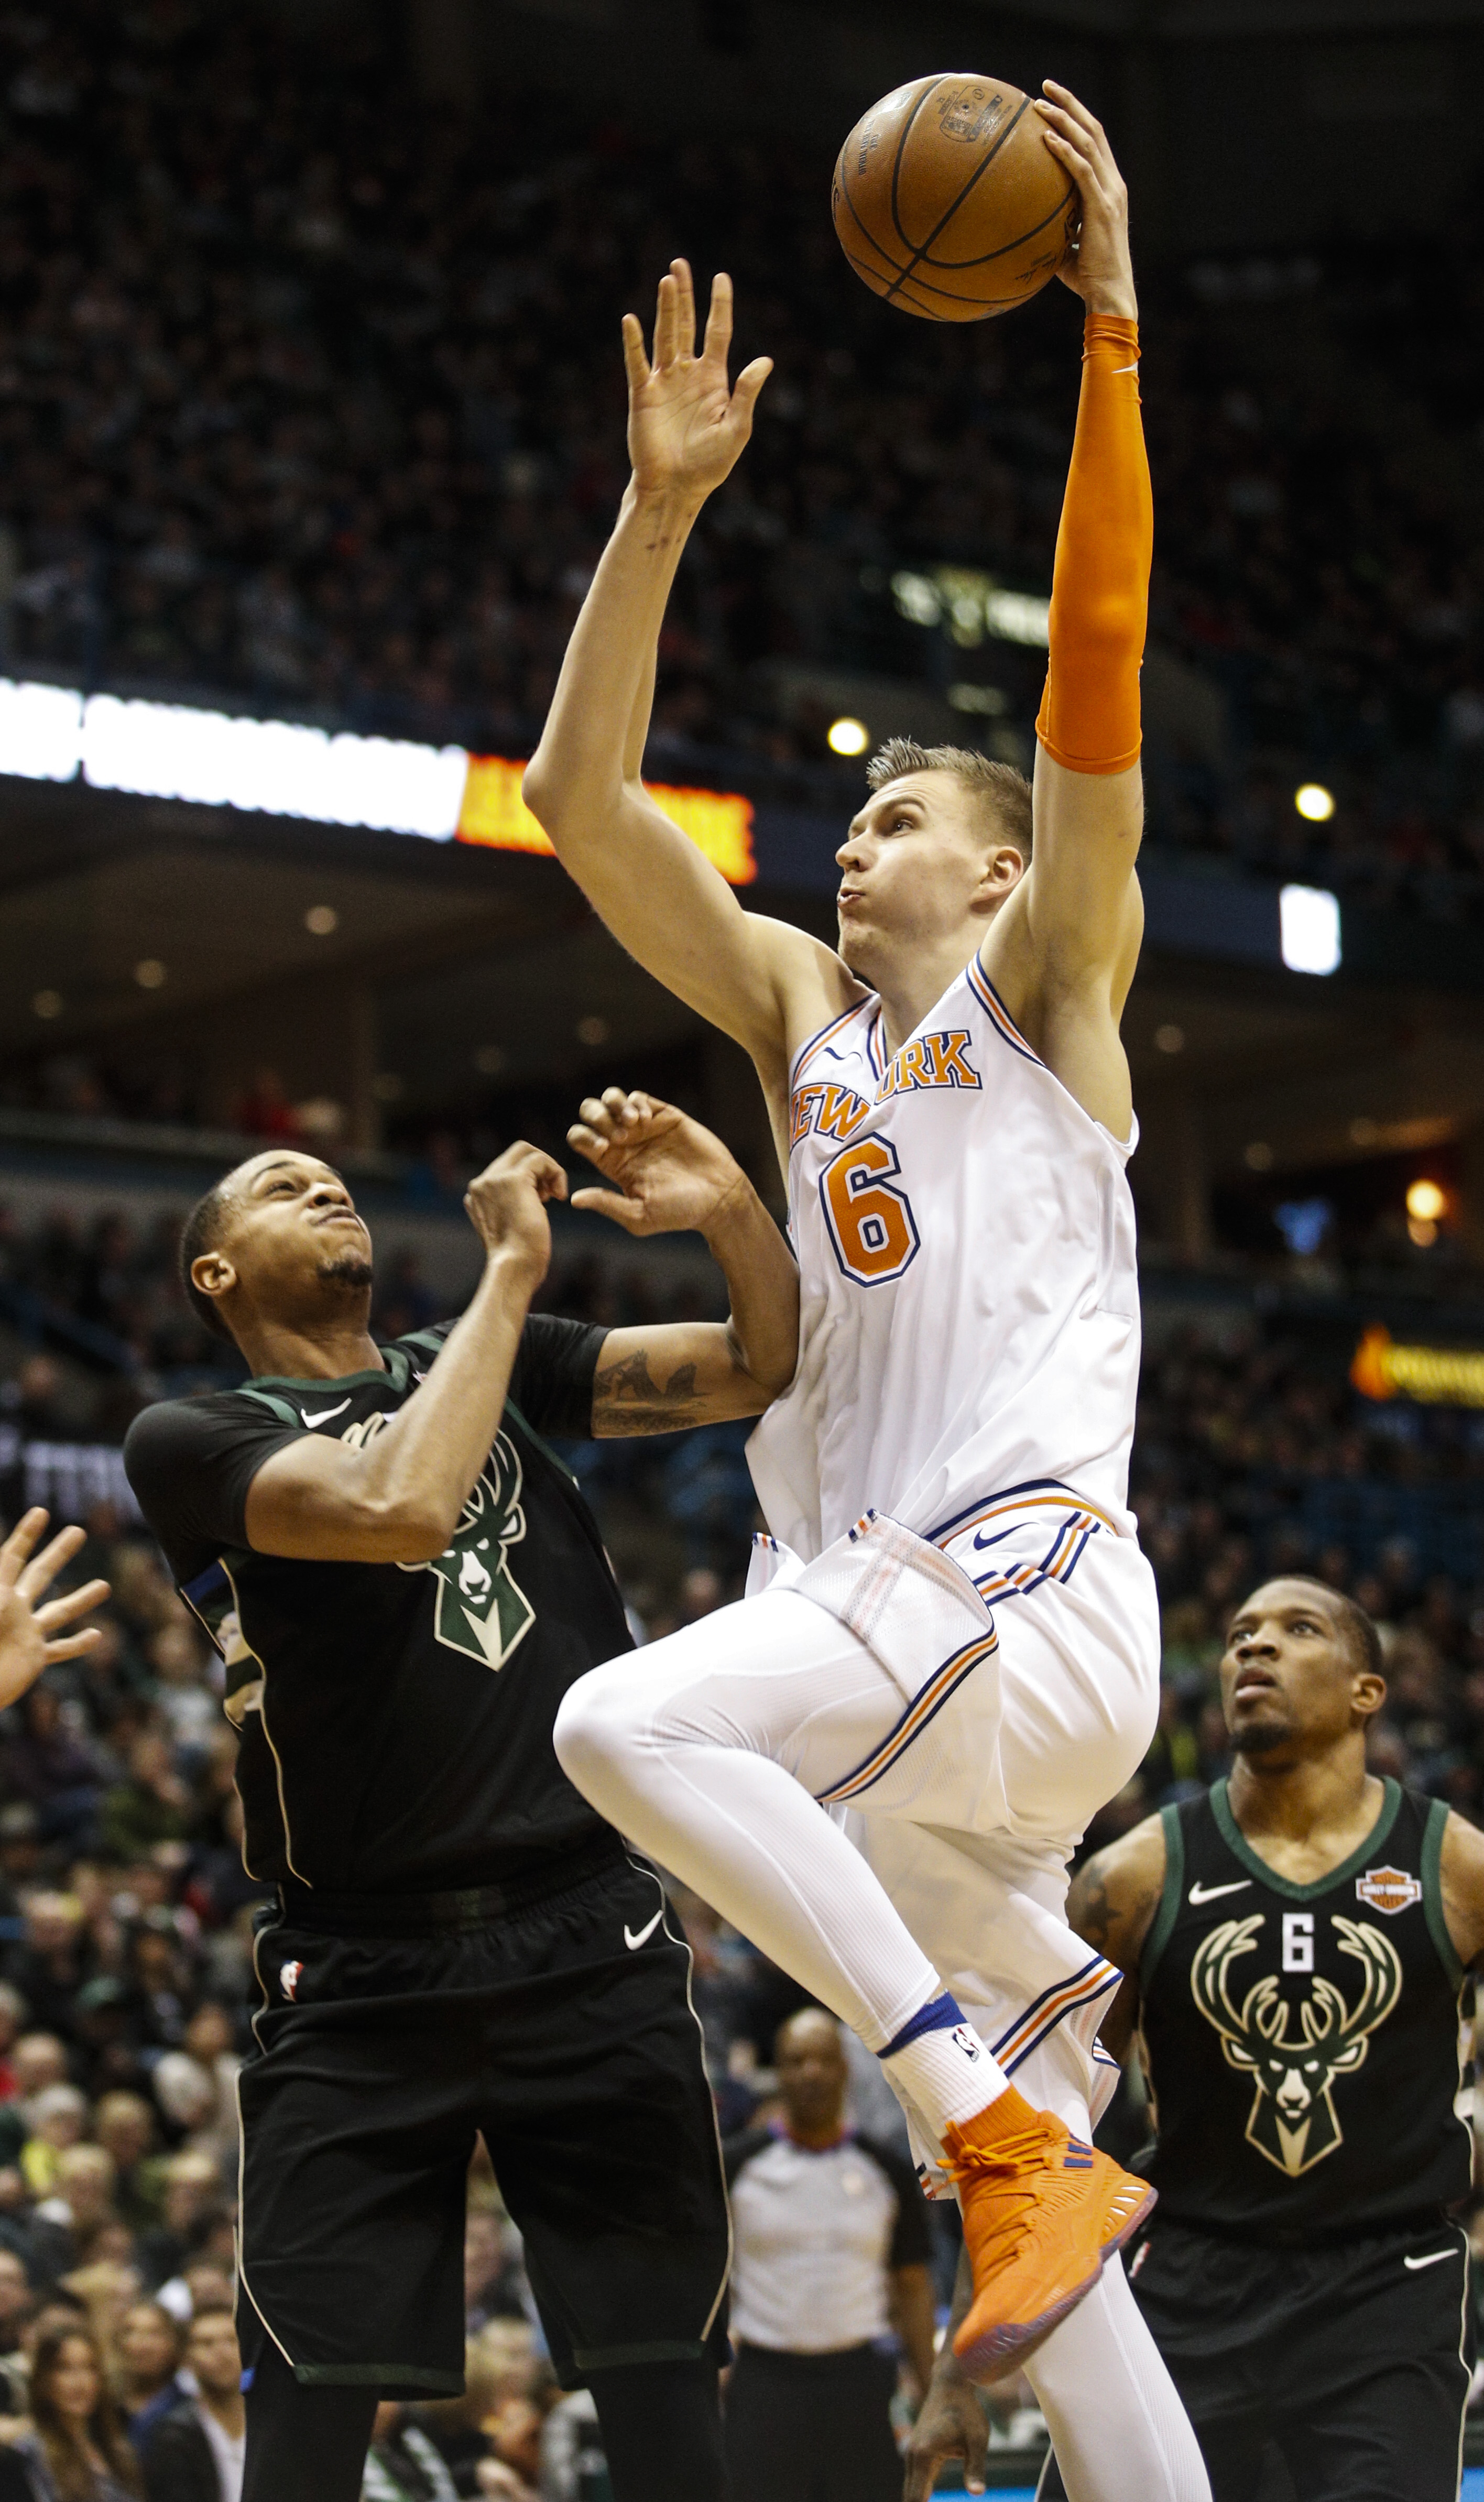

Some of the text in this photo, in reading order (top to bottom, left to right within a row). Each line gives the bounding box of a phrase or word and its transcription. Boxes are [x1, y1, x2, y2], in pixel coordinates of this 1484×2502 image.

[874, 1030, 983, 1106] ORK
[819, 1132, 921, 1288] 6
[1282, 1913, 1315, 1972] 6
